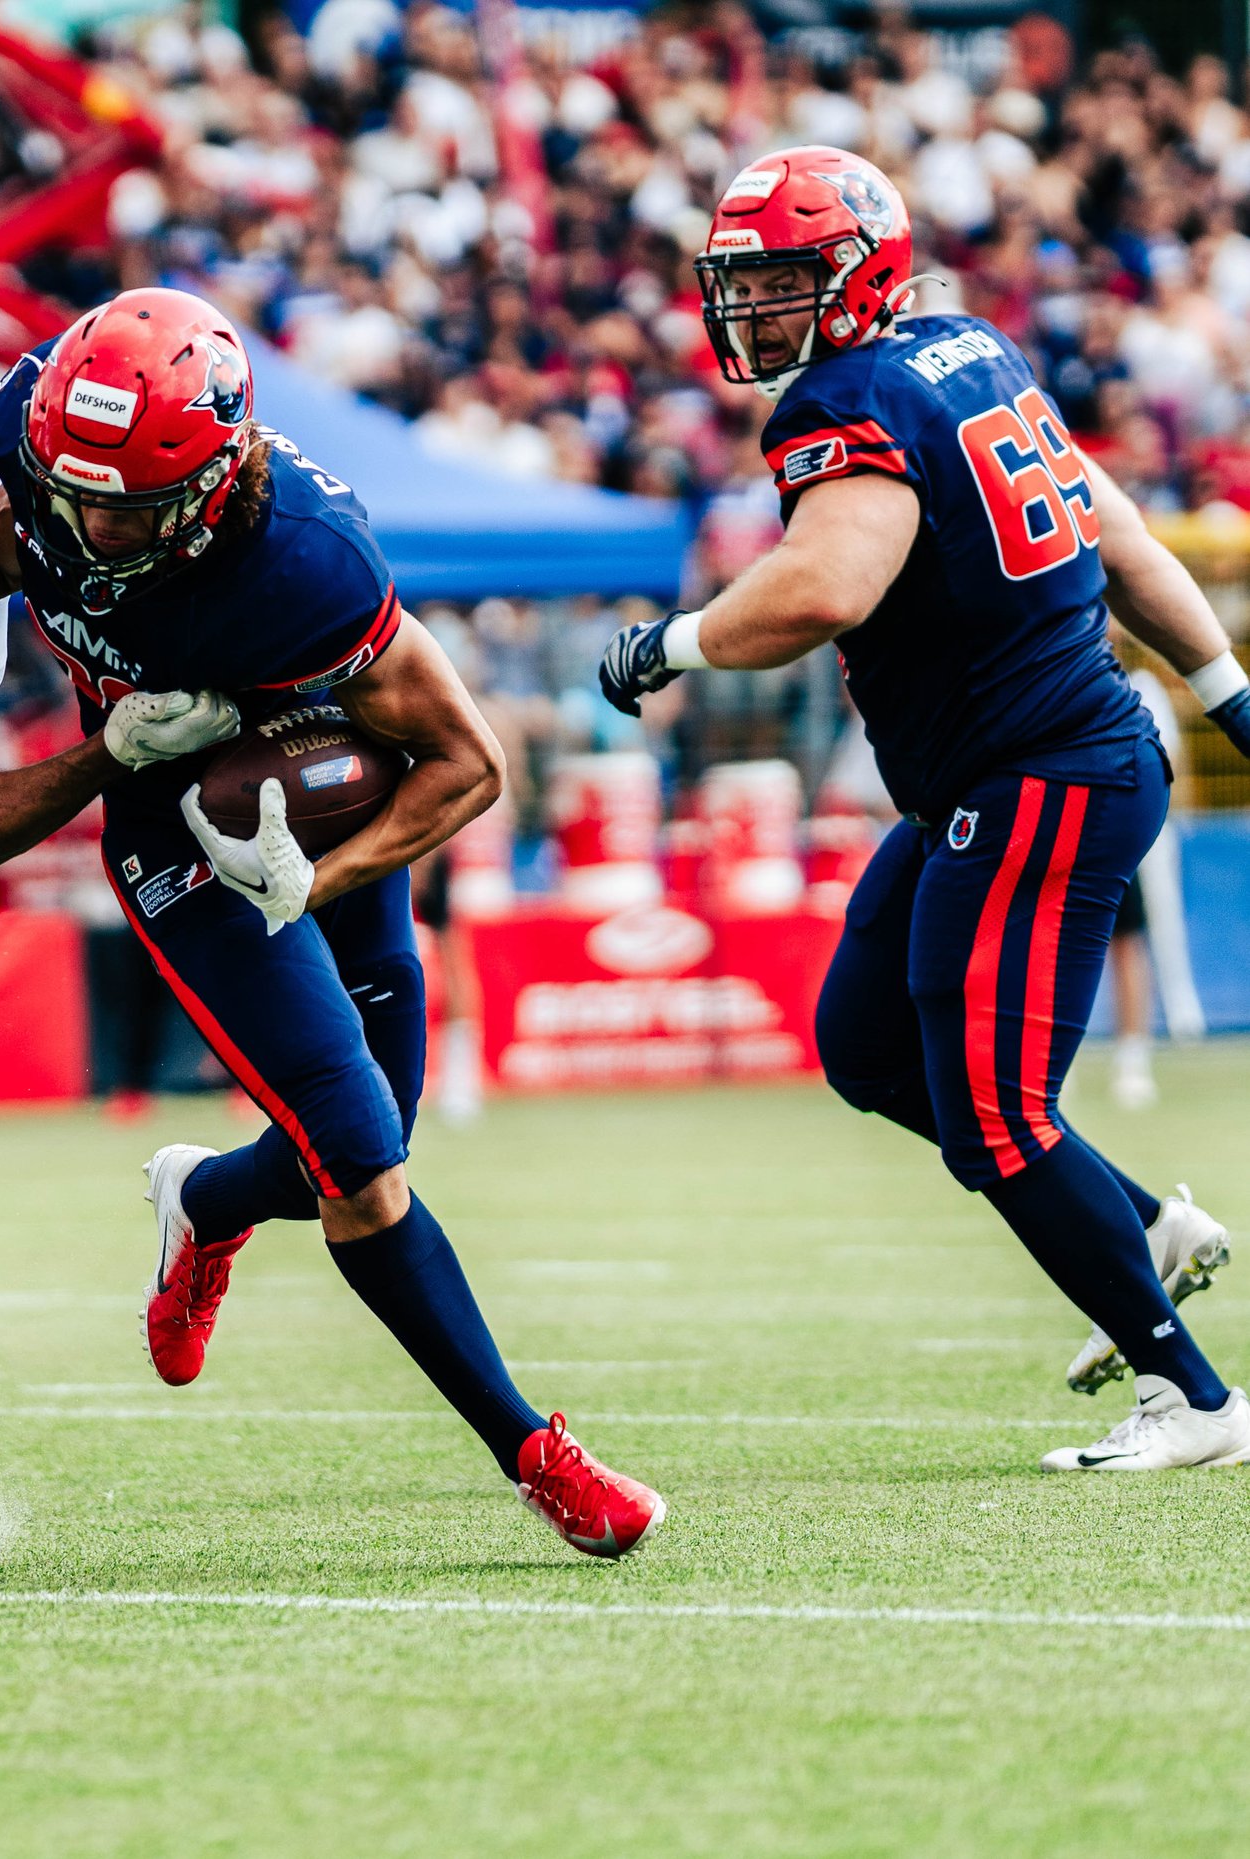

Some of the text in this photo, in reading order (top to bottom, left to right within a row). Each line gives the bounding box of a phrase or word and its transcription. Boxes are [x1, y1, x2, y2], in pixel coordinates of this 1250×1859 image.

[74, 392, 127, 414] DEFSHOP
[957, 386, 1100, 581] 69
[279, 734, 353, 758] Wilson
[308, 776, 337, 788] FOOTBALL
[140, 876, 171, 900] EUROPEAN
[144, 889, 164, 906] LEAGUE
[147, 889, 176, 912] FOOTBALL
